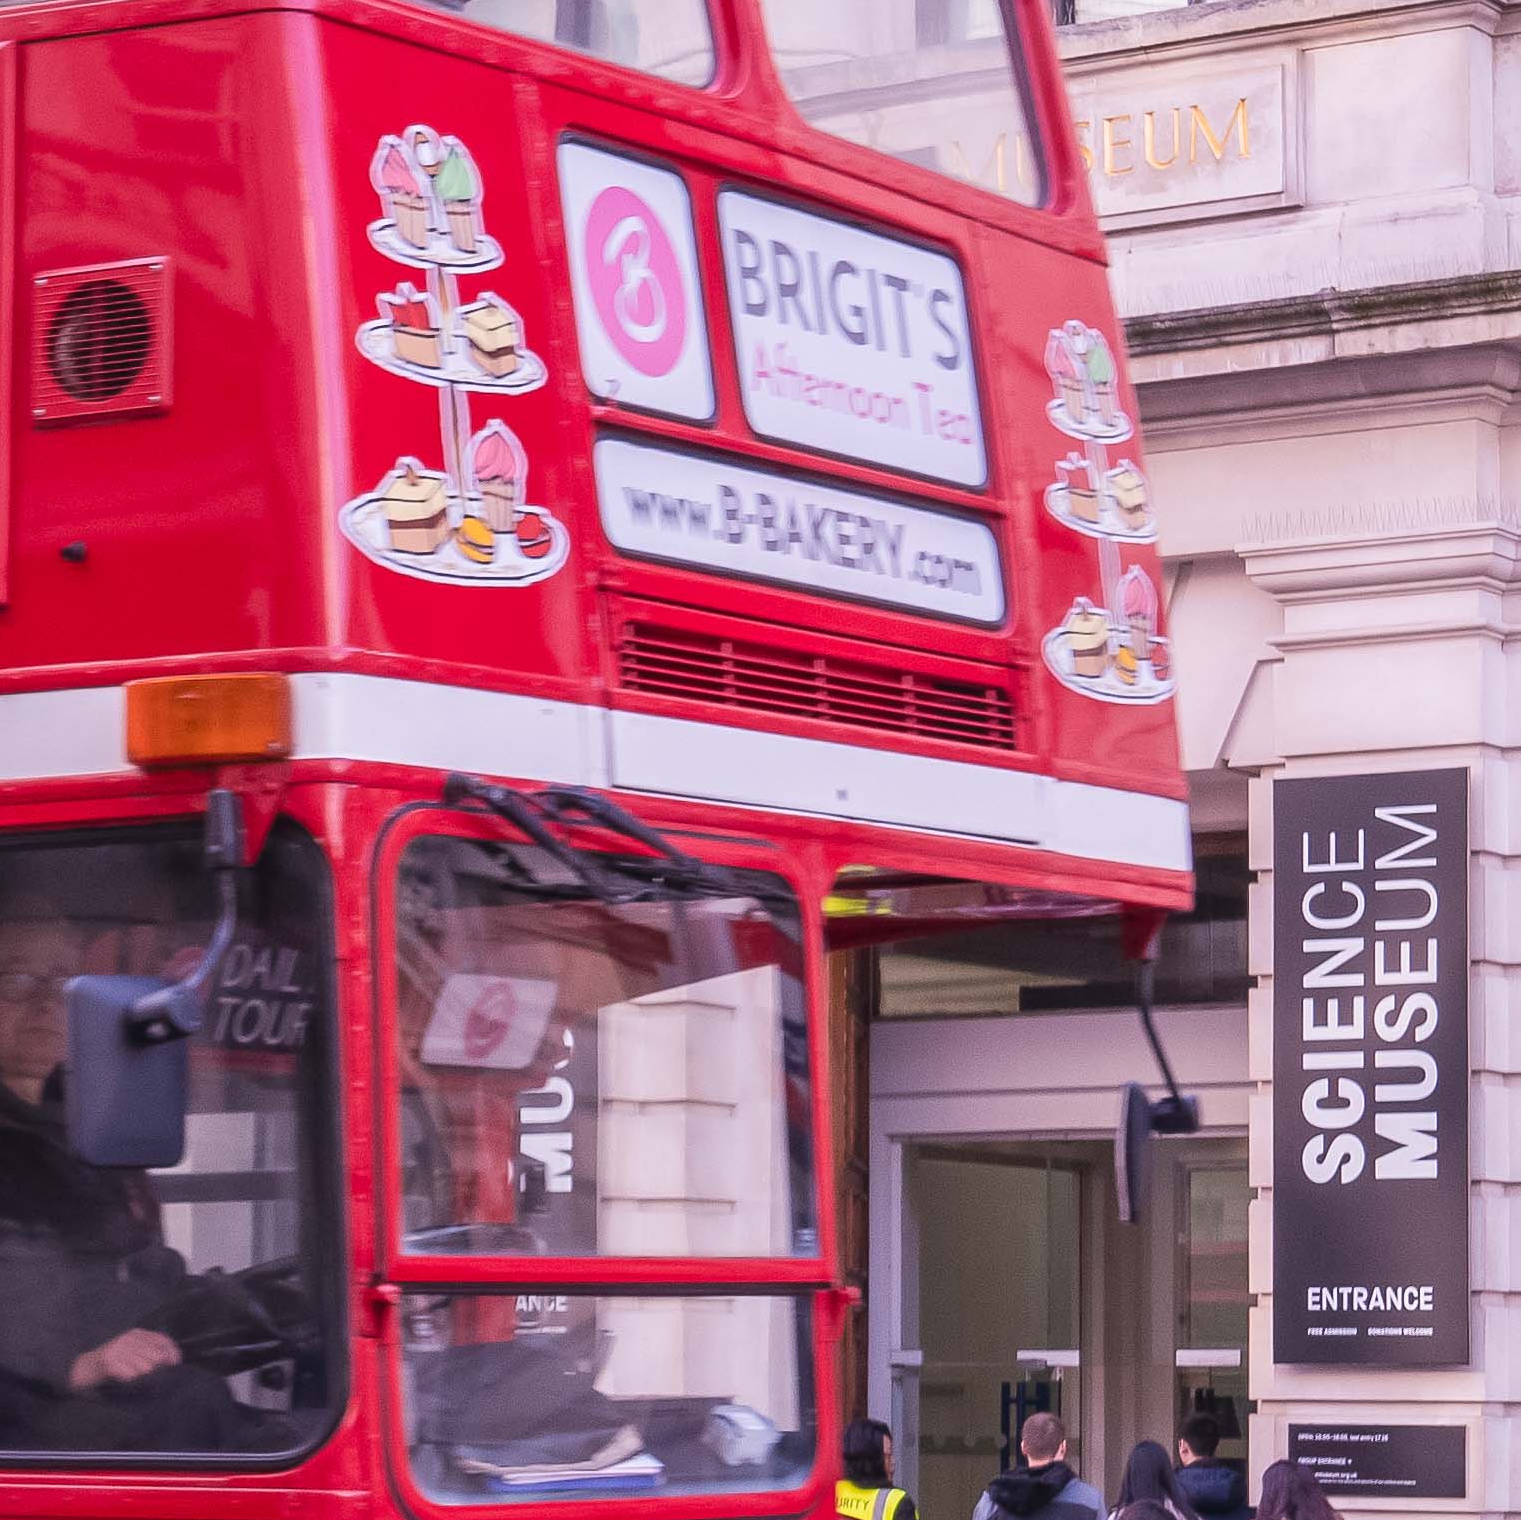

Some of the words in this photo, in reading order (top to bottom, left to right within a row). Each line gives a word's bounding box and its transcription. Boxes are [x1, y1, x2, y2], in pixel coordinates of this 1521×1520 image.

[731, 229, 960, 371] BRIGIT'S
[751, 342, 912, 431] Afternoon
[910, 381, 975, 445] Tea
[622, 483, 984, 597] www.B-BAKERY.com
[221, 943, 303, 993] DAIL
[1302, 828, 1366, 1185] SCIENCE
[1373, 804, 1438, 1180] MUSEUM
[1307, 1285, 1434, 1311] ENTRANCE
